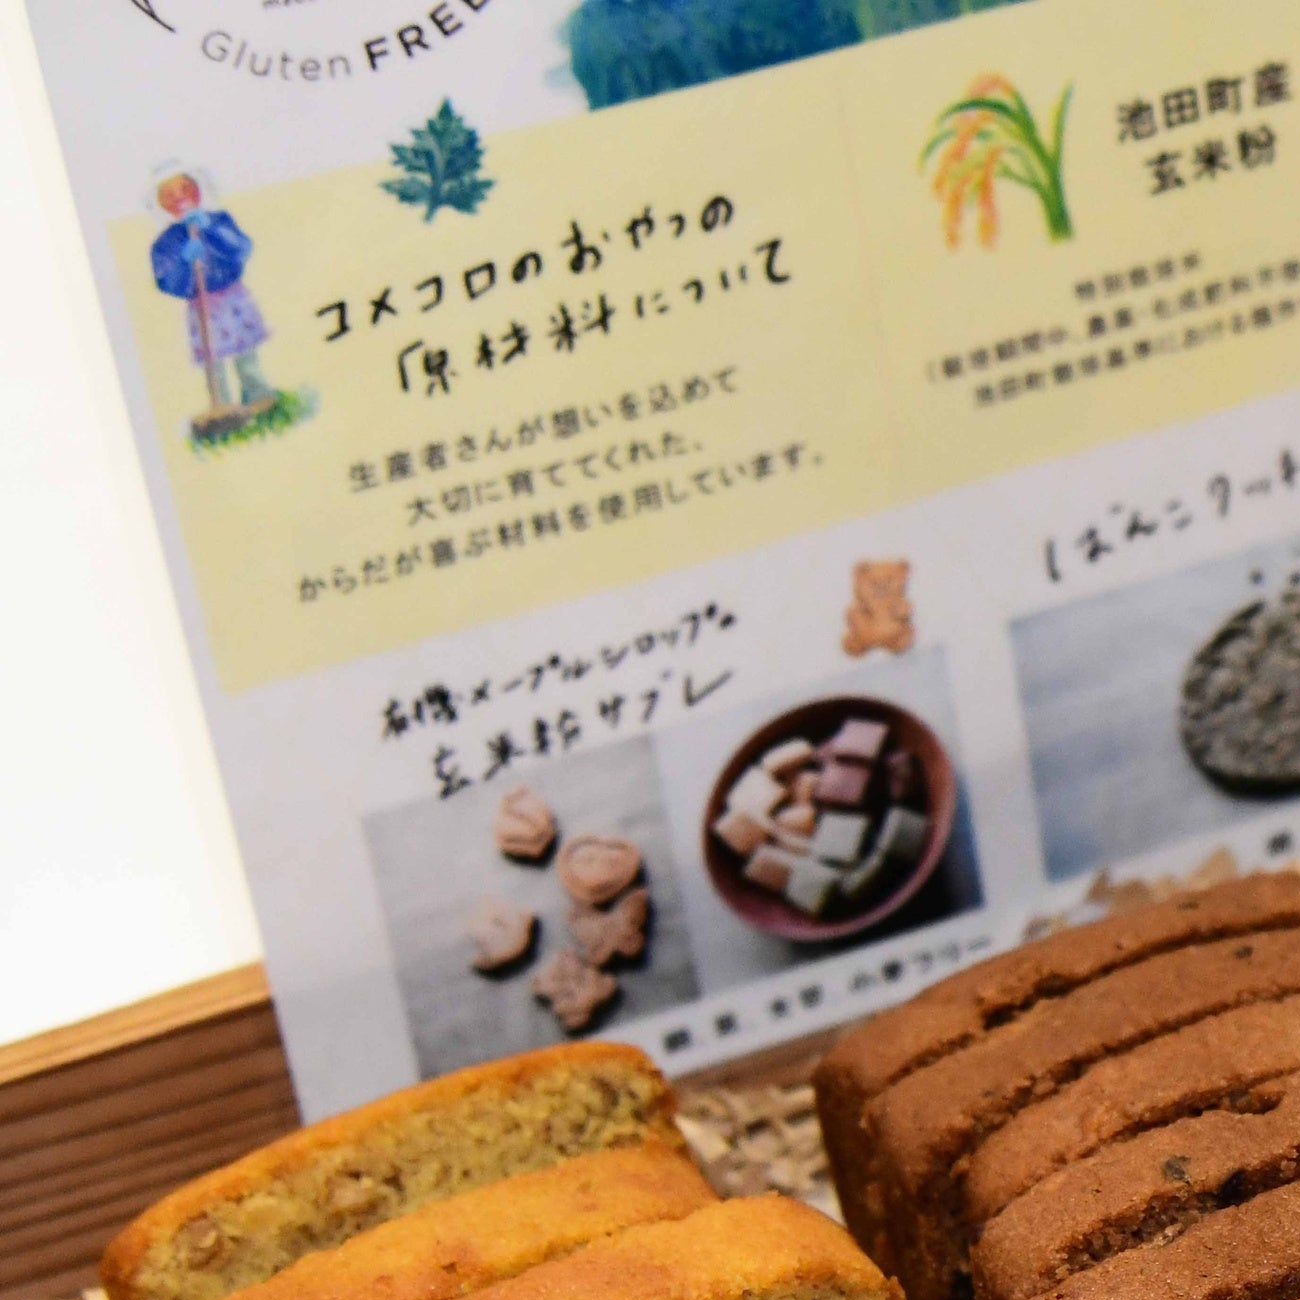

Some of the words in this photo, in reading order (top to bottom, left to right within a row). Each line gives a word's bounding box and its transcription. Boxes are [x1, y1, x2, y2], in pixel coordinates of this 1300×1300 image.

[201, 30, 351, 81] Gluten
[1117, 61, 1294, 145] 池田町産
[1144, 124, 1278, 196] 玄米粉
[316, 196, 734, 342] コメコロのおやつの
[349, 366, 738, 494] 生産者さんが想いを込めて
